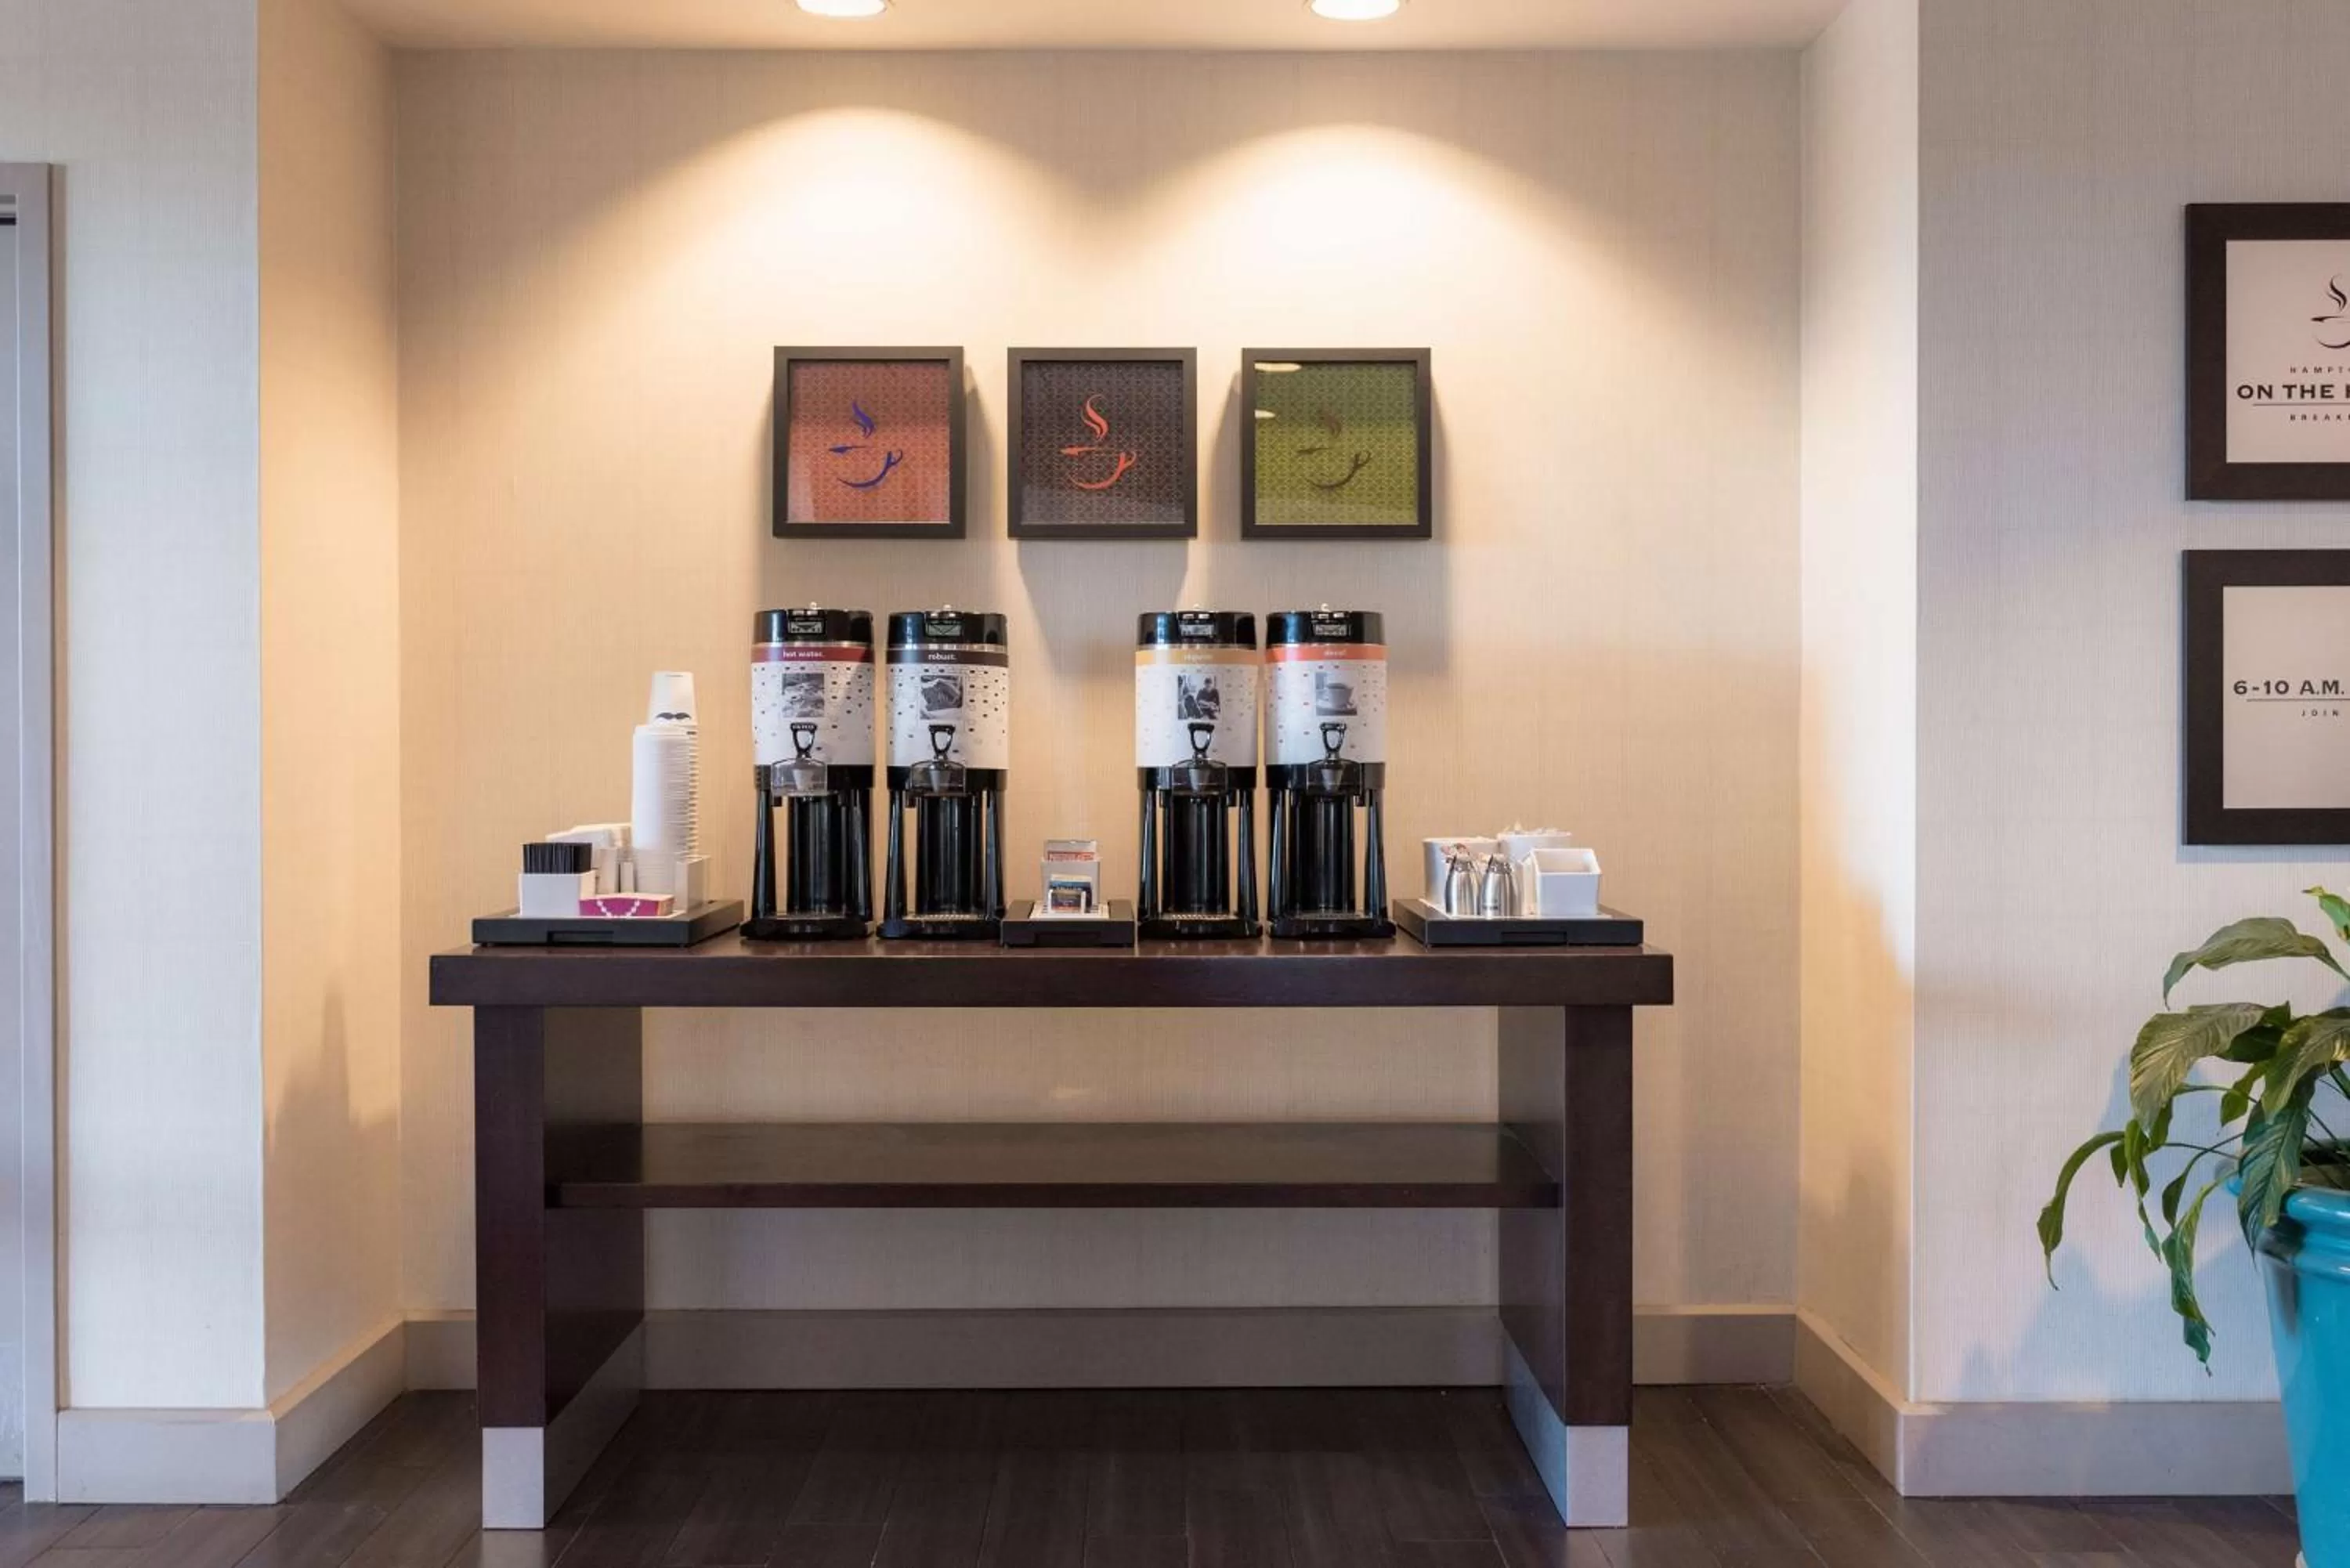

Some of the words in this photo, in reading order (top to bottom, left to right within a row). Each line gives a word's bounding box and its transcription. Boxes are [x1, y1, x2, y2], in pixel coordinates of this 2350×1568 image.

[2237, 384, 2273, 399] ON
[2282, 384, 2334, 399] THE
[2233, 680, 2290, 695] 6-10
[2299, 679, 2345, 695] A.M.
